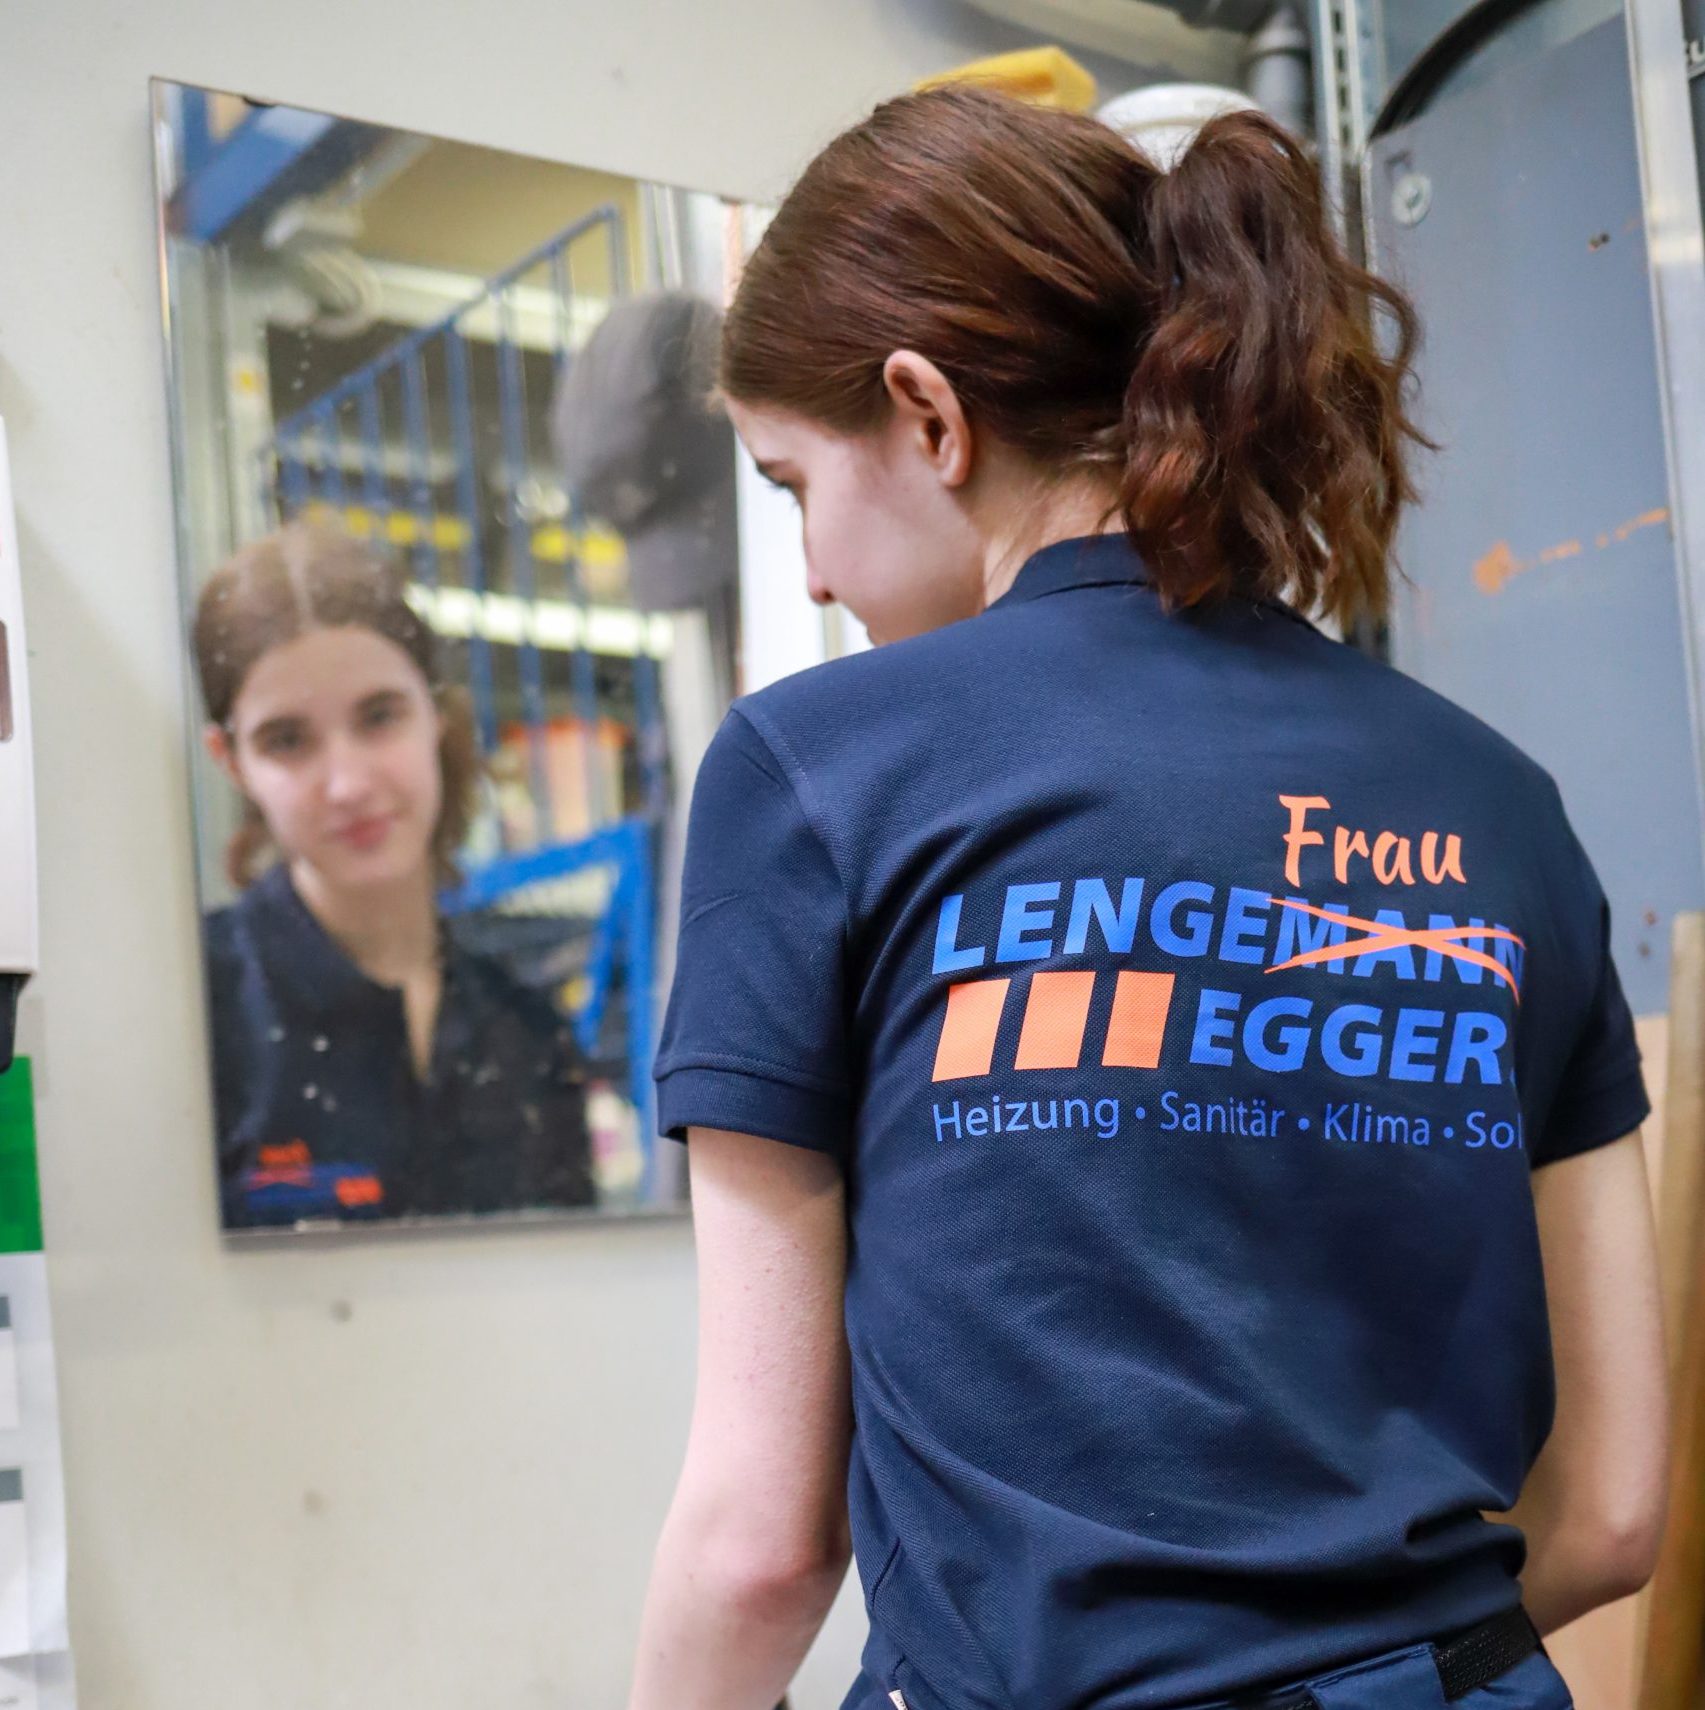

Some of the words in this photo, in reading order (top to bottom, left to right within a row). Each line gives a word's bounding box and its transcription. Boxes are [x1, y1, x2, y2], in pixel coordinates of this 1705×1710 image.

[1278, 794, 1466, 887] Frau
[931, 876, 1526, 989] LENGEMANN
[1188, 988, 1517, 1086] EGGER
[932, 1095, 1121, 1144] Heizung
[1159, 1090, 1286, 1138] Sanitär
[1322, 1102, 1431, 1147] Klima
